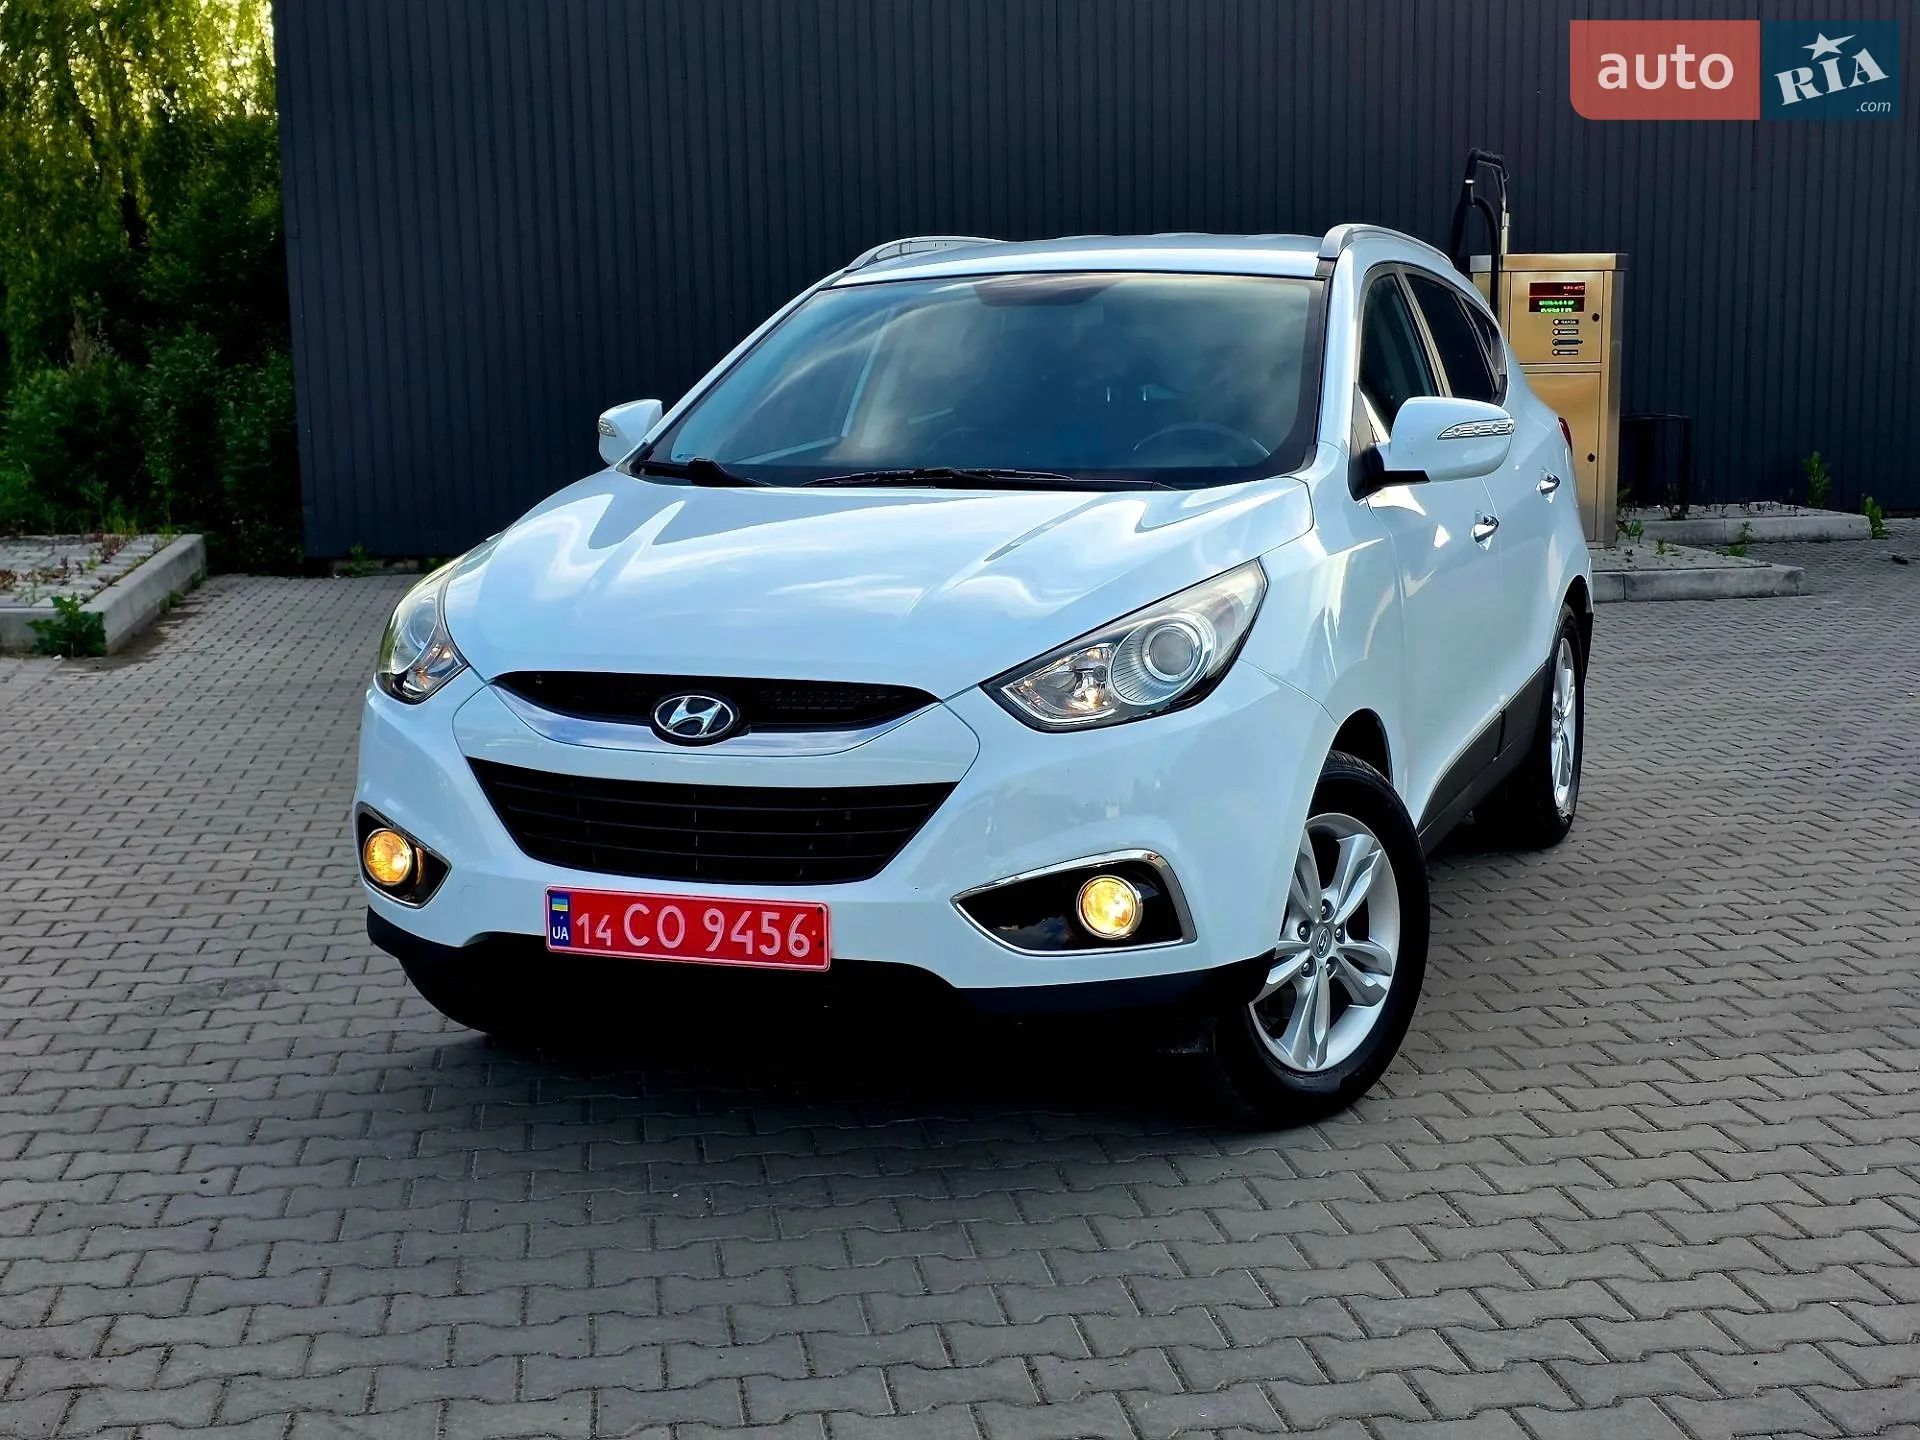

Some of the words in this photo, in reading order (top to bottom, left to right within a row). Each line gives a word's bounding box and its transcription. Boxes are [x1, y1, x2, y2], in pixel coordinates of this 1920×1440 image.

[552, 926, 569, 941] UA
[576, 912, 612, 947] 14
[624, 903, 686, 949] CO
[702, 908, 810, 958] 9456
